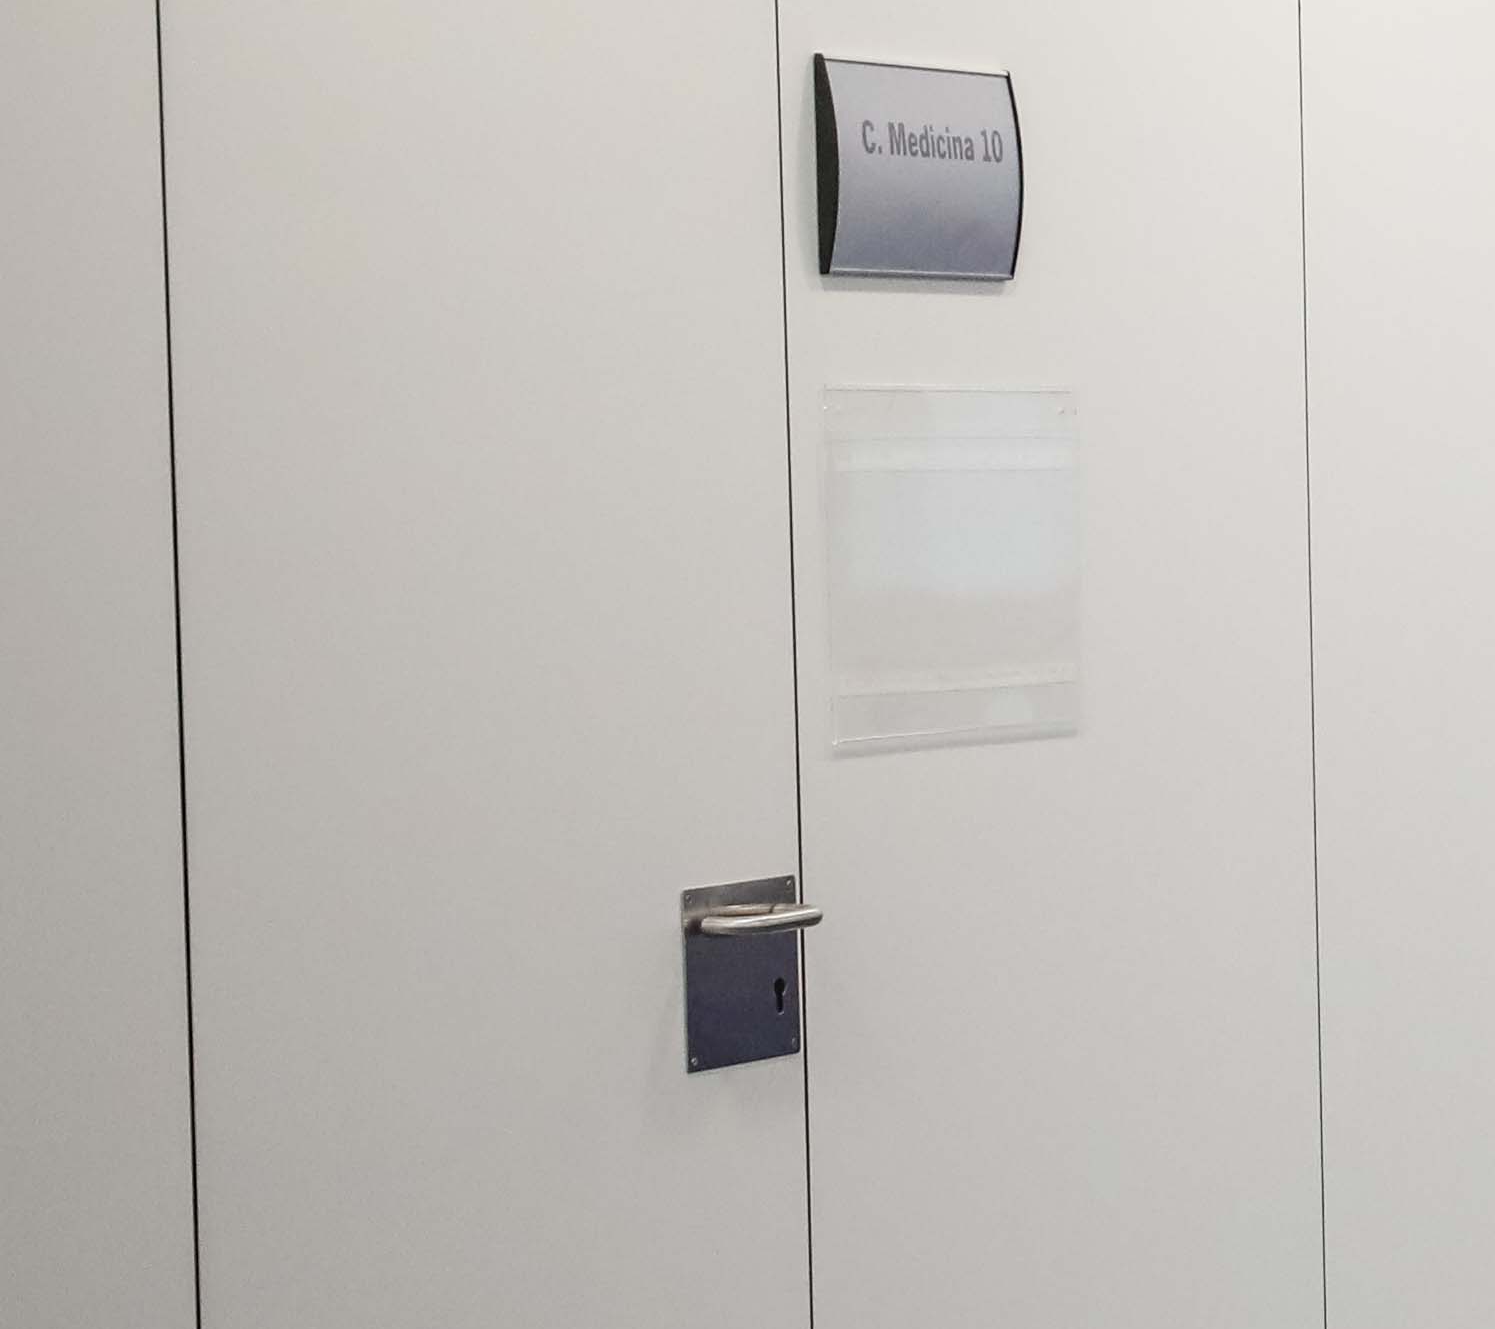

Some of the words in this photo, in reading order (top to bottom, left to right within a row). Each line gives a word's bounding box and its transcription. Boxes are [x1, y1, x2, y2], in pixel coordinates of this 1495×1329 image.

[861, 119, 883, 155] C.
[887, 121, 975, 161] Medicina
[980, 129, 1004, 164] 10
